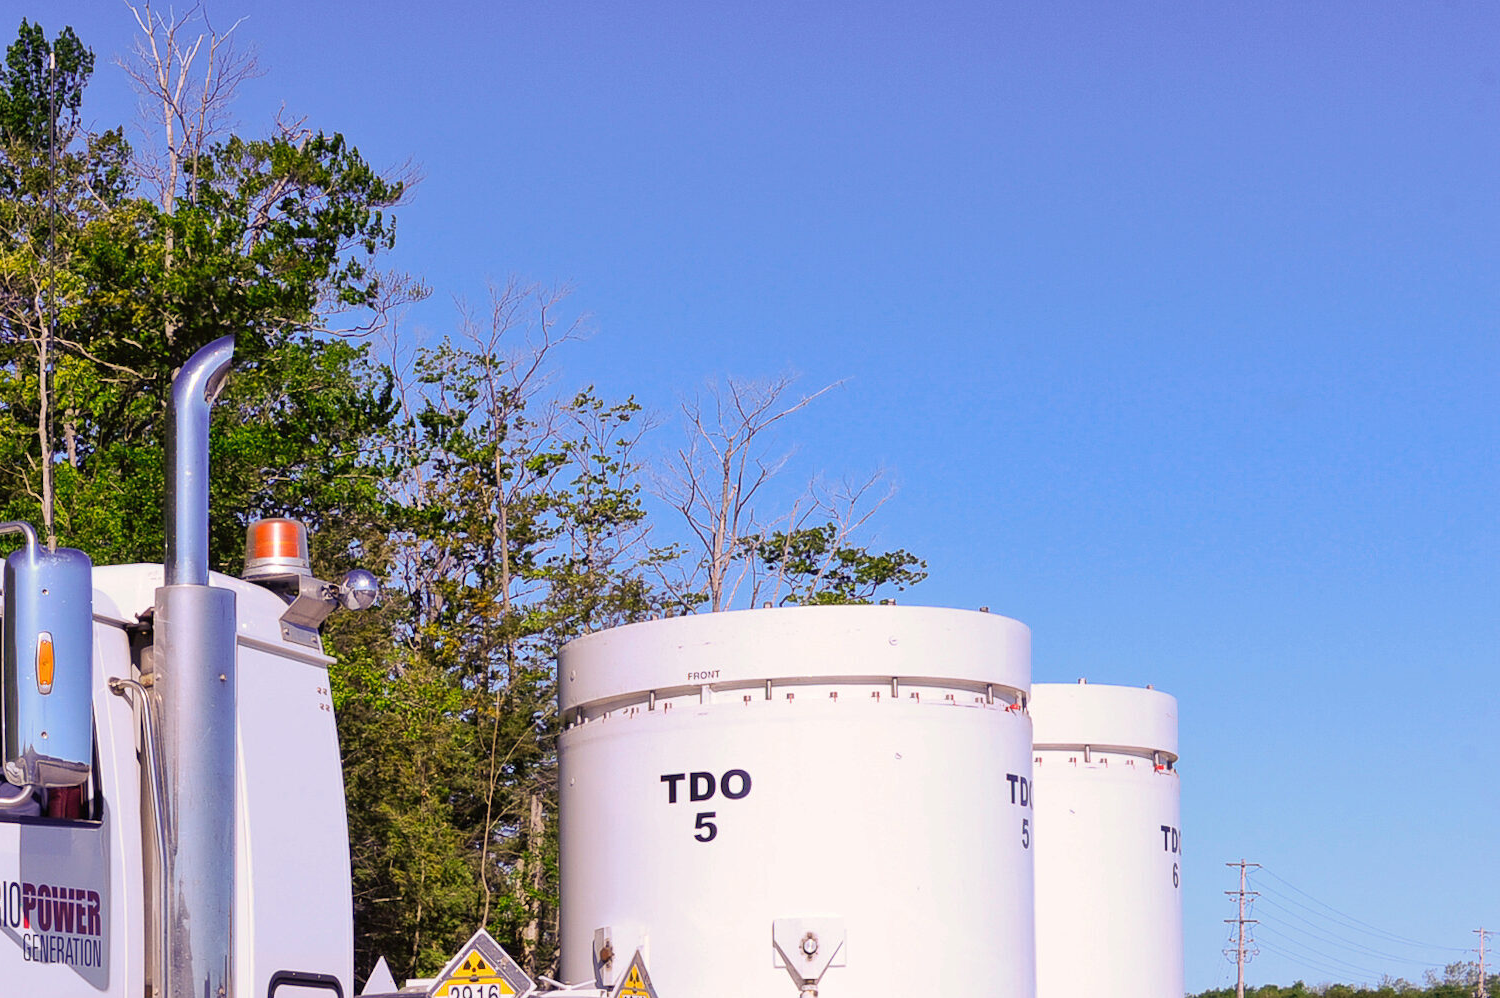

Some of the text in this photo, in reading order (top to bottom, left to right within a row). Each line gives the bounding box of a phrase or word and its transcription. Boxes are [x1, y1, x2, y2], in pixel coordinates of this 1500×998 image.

[687, 669, 721, 681] FRONT
[660, 769, 752, 804] TDO
[694, 811, 718, 842] 5
[1021, 818, 1030, 849] 5
[1172, 862, 1179, 889] 6
[22, 933, 102, 967] GENERATION
